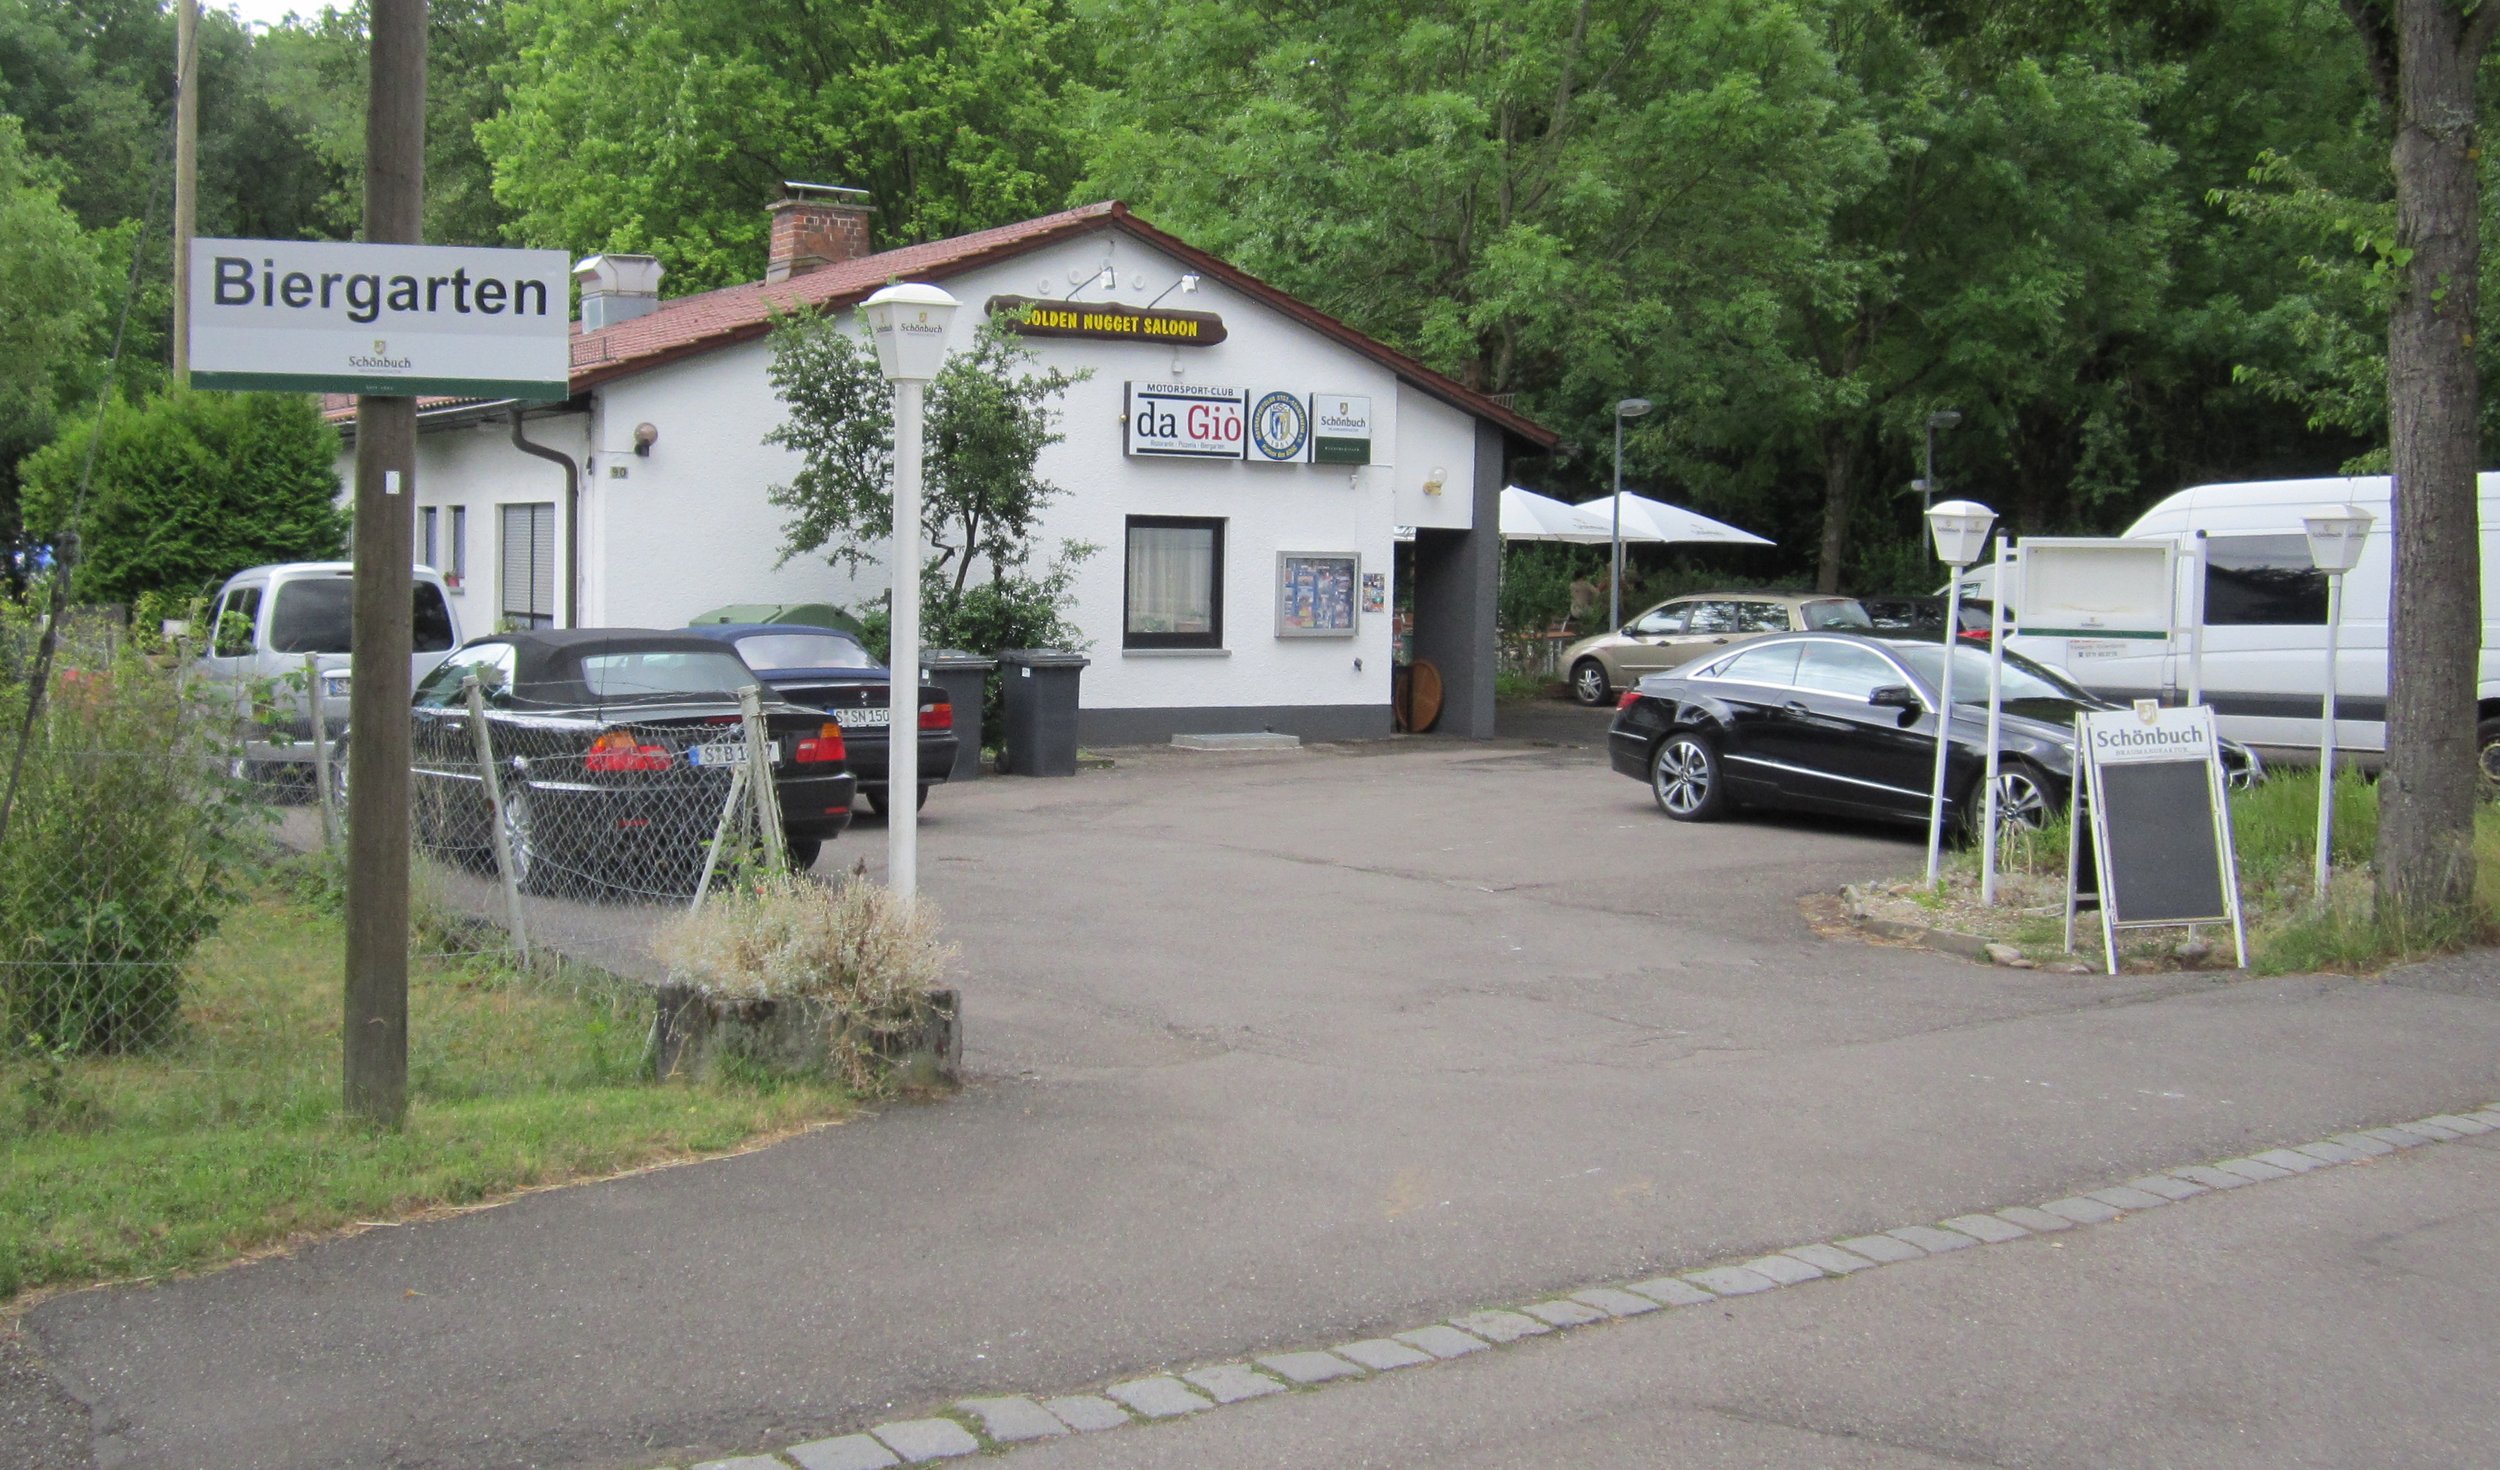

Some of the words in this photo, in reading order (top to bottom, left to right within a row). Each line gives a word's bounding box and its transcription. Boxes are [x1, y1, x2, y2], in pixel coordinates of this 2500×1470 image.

[213, 256, 547, 324] Biergarten
[901, 323, 943, 333] Schönbuch
[1083, 313, 1140, 333] NUGGET
[1143, 319, 1198, 337] SALOON
[348, 356, 412, 368] Schönbuch
[1137, 401, 1178, 438] da
[1187, 404, 1242, 442] Giò
[1321, 415, 1366, 428] Schönbuch
[836, 711, 843, 723] S
[851, 710, 866, 723] SN
[2097, 725, 2203, 747] Schönbuch
[705, 747, 714, 762] S
[724, 745, 733, 761] B
